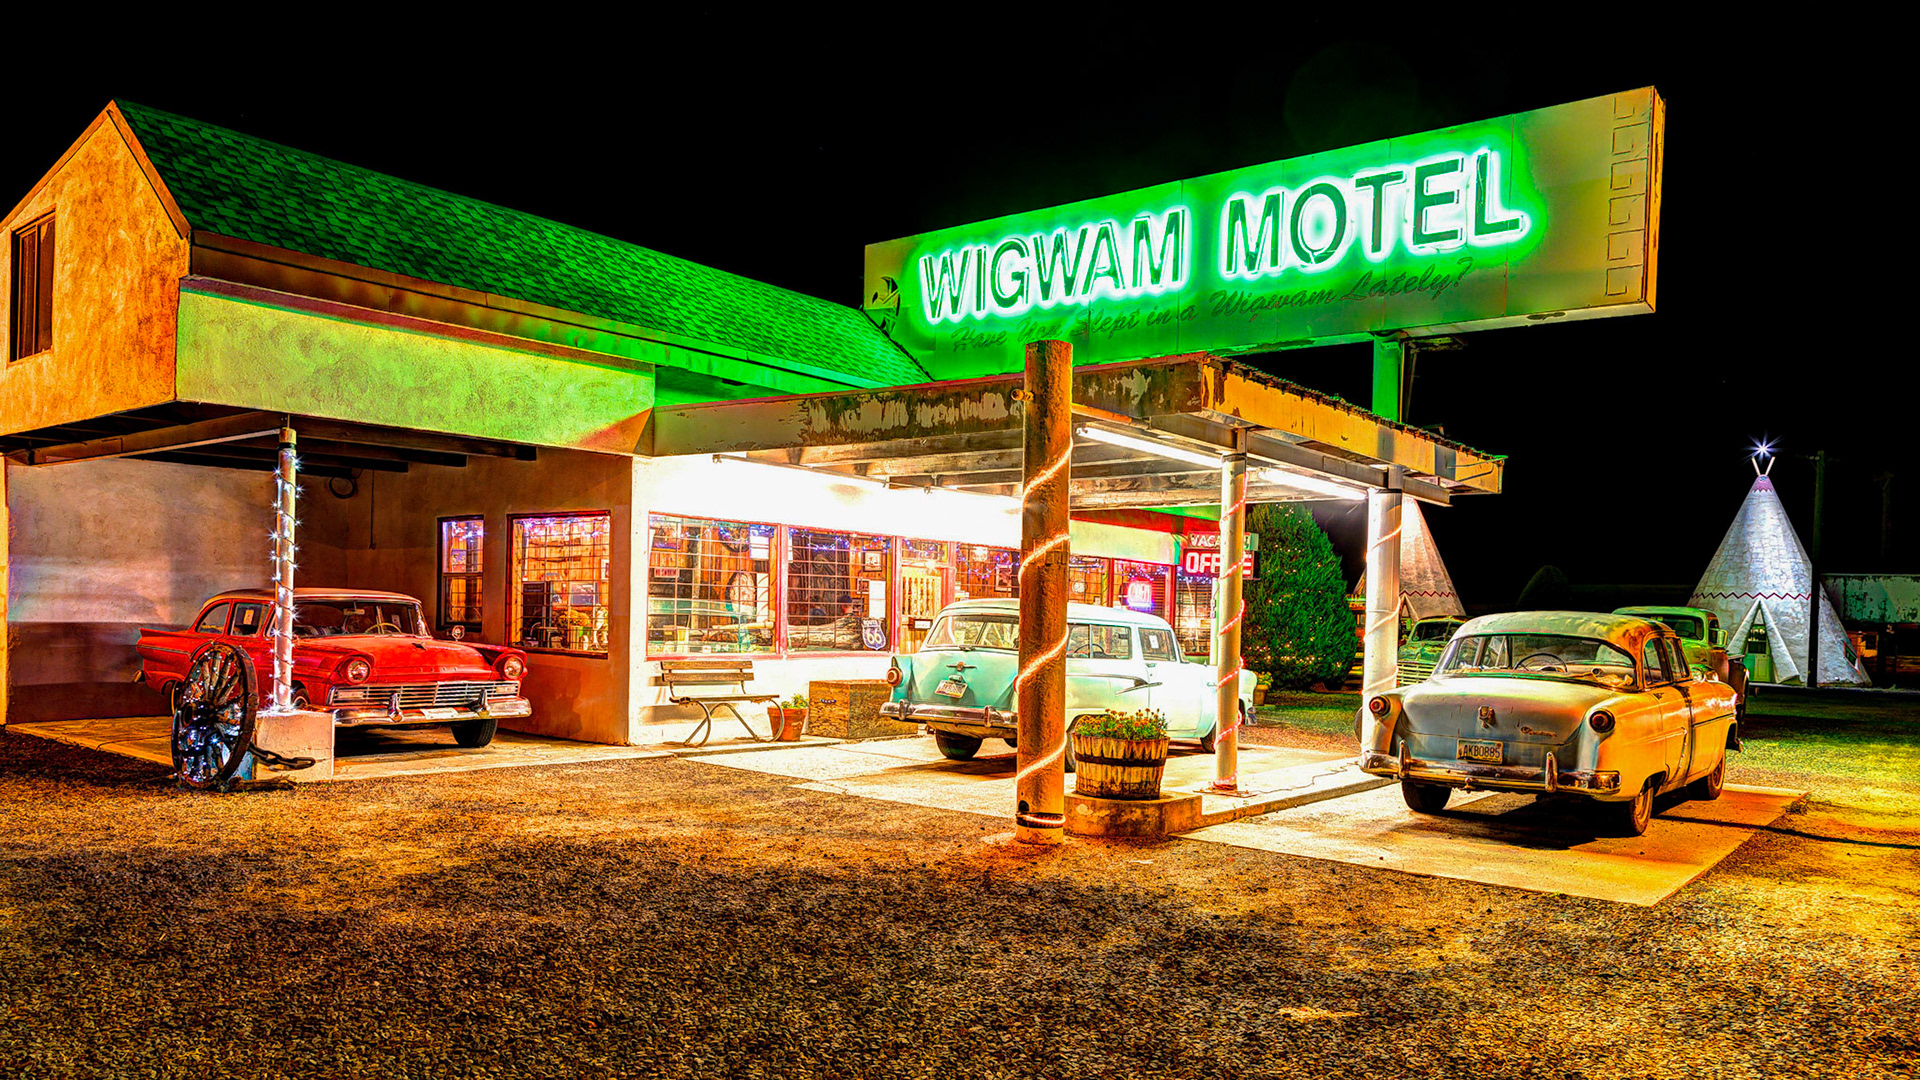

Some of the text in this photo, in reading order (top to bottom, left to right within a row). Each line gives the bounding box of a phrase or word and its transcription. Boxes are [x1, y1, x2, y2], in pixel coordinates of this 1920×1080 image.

[919, 151, 1524, 319] WIGWAM MOTEL
[951, 256, 1474, 351] Have You Slept in a Wigwam Lately?
[1186, 552, 1252, 574] OFFE
[867, 628, 882, 644] 66
